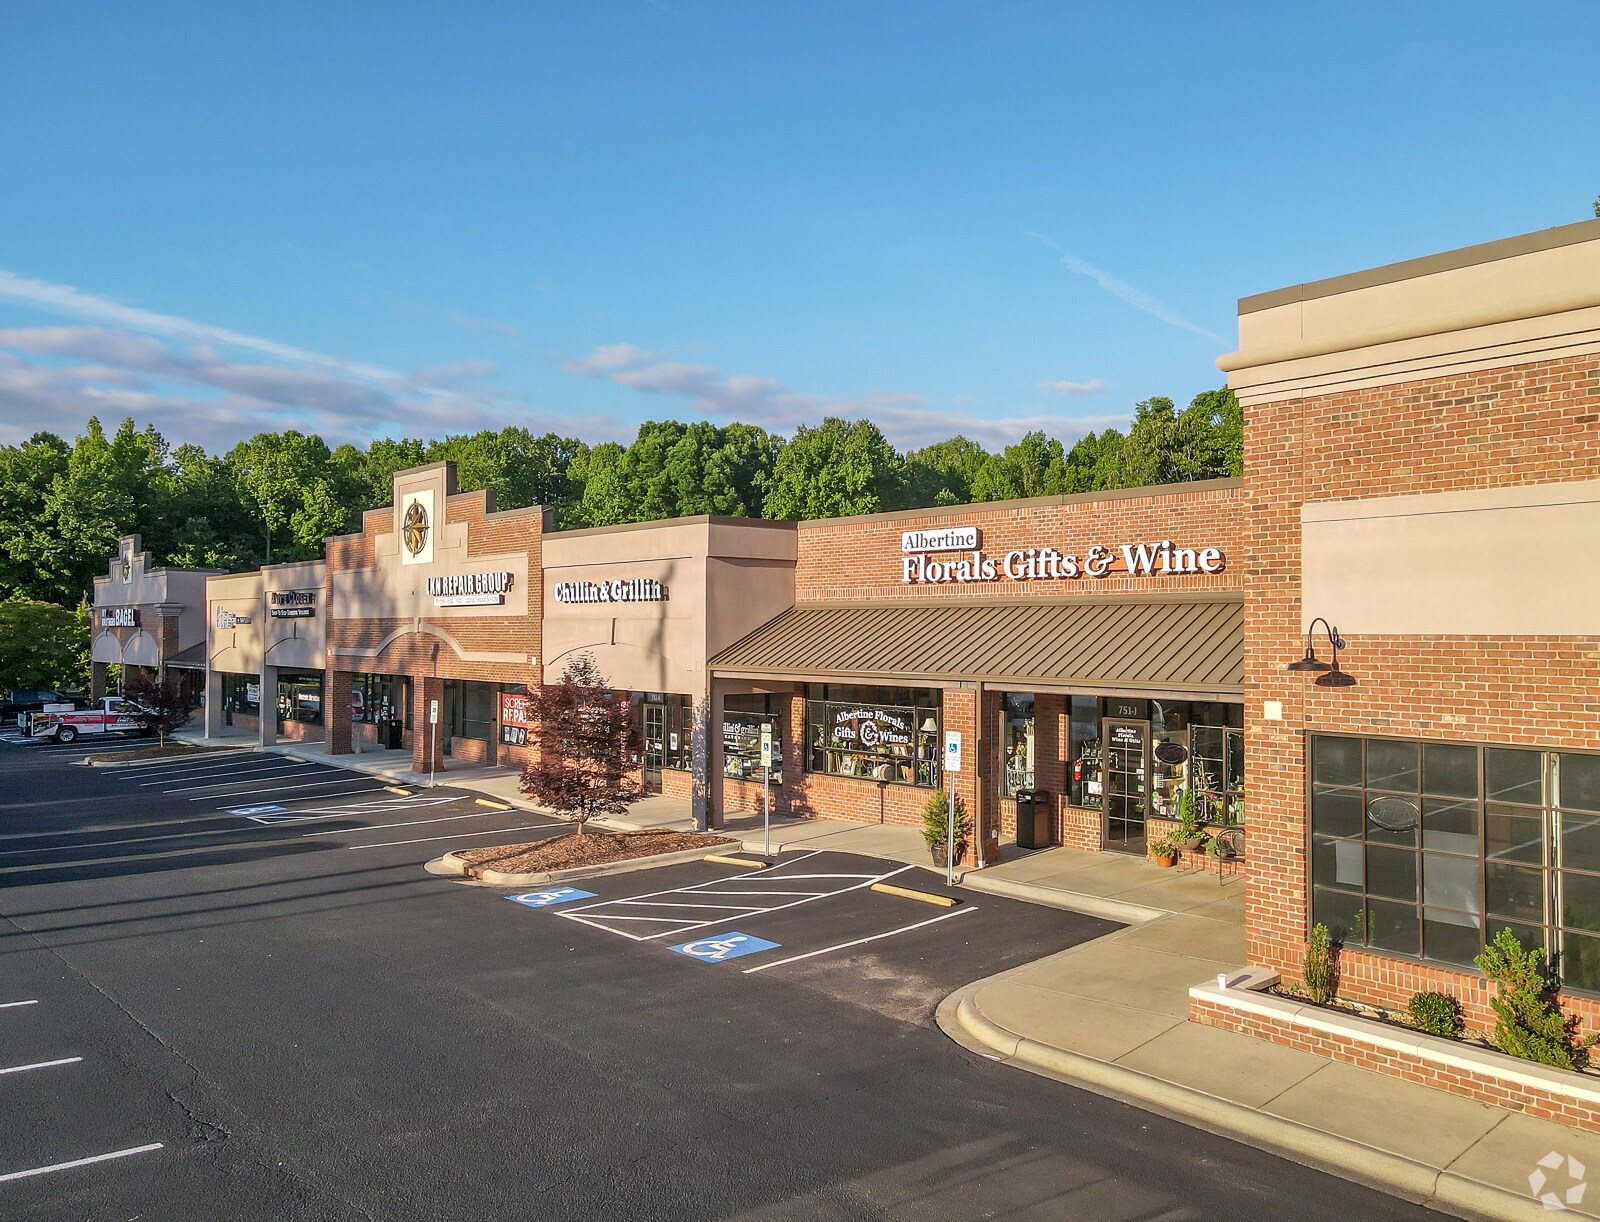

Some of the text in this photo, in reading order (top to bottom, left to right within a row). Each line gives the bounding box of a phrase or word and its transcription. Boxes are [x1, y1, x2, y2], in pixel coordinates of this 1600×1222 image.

[904, 531, 974, 549] Albertine
[901, 539, 1220, 582] Florals Gifts & Wine
[427, 571, 508, 595] LKN REPAIR GROUP
[115, 608, 135, 627] BAGEL
[836, 708, 905, 730] Albertine Florals
[1118, 705, 1137, 715] 751-J
[834, 726, 909, 744] Gifts & Wines
